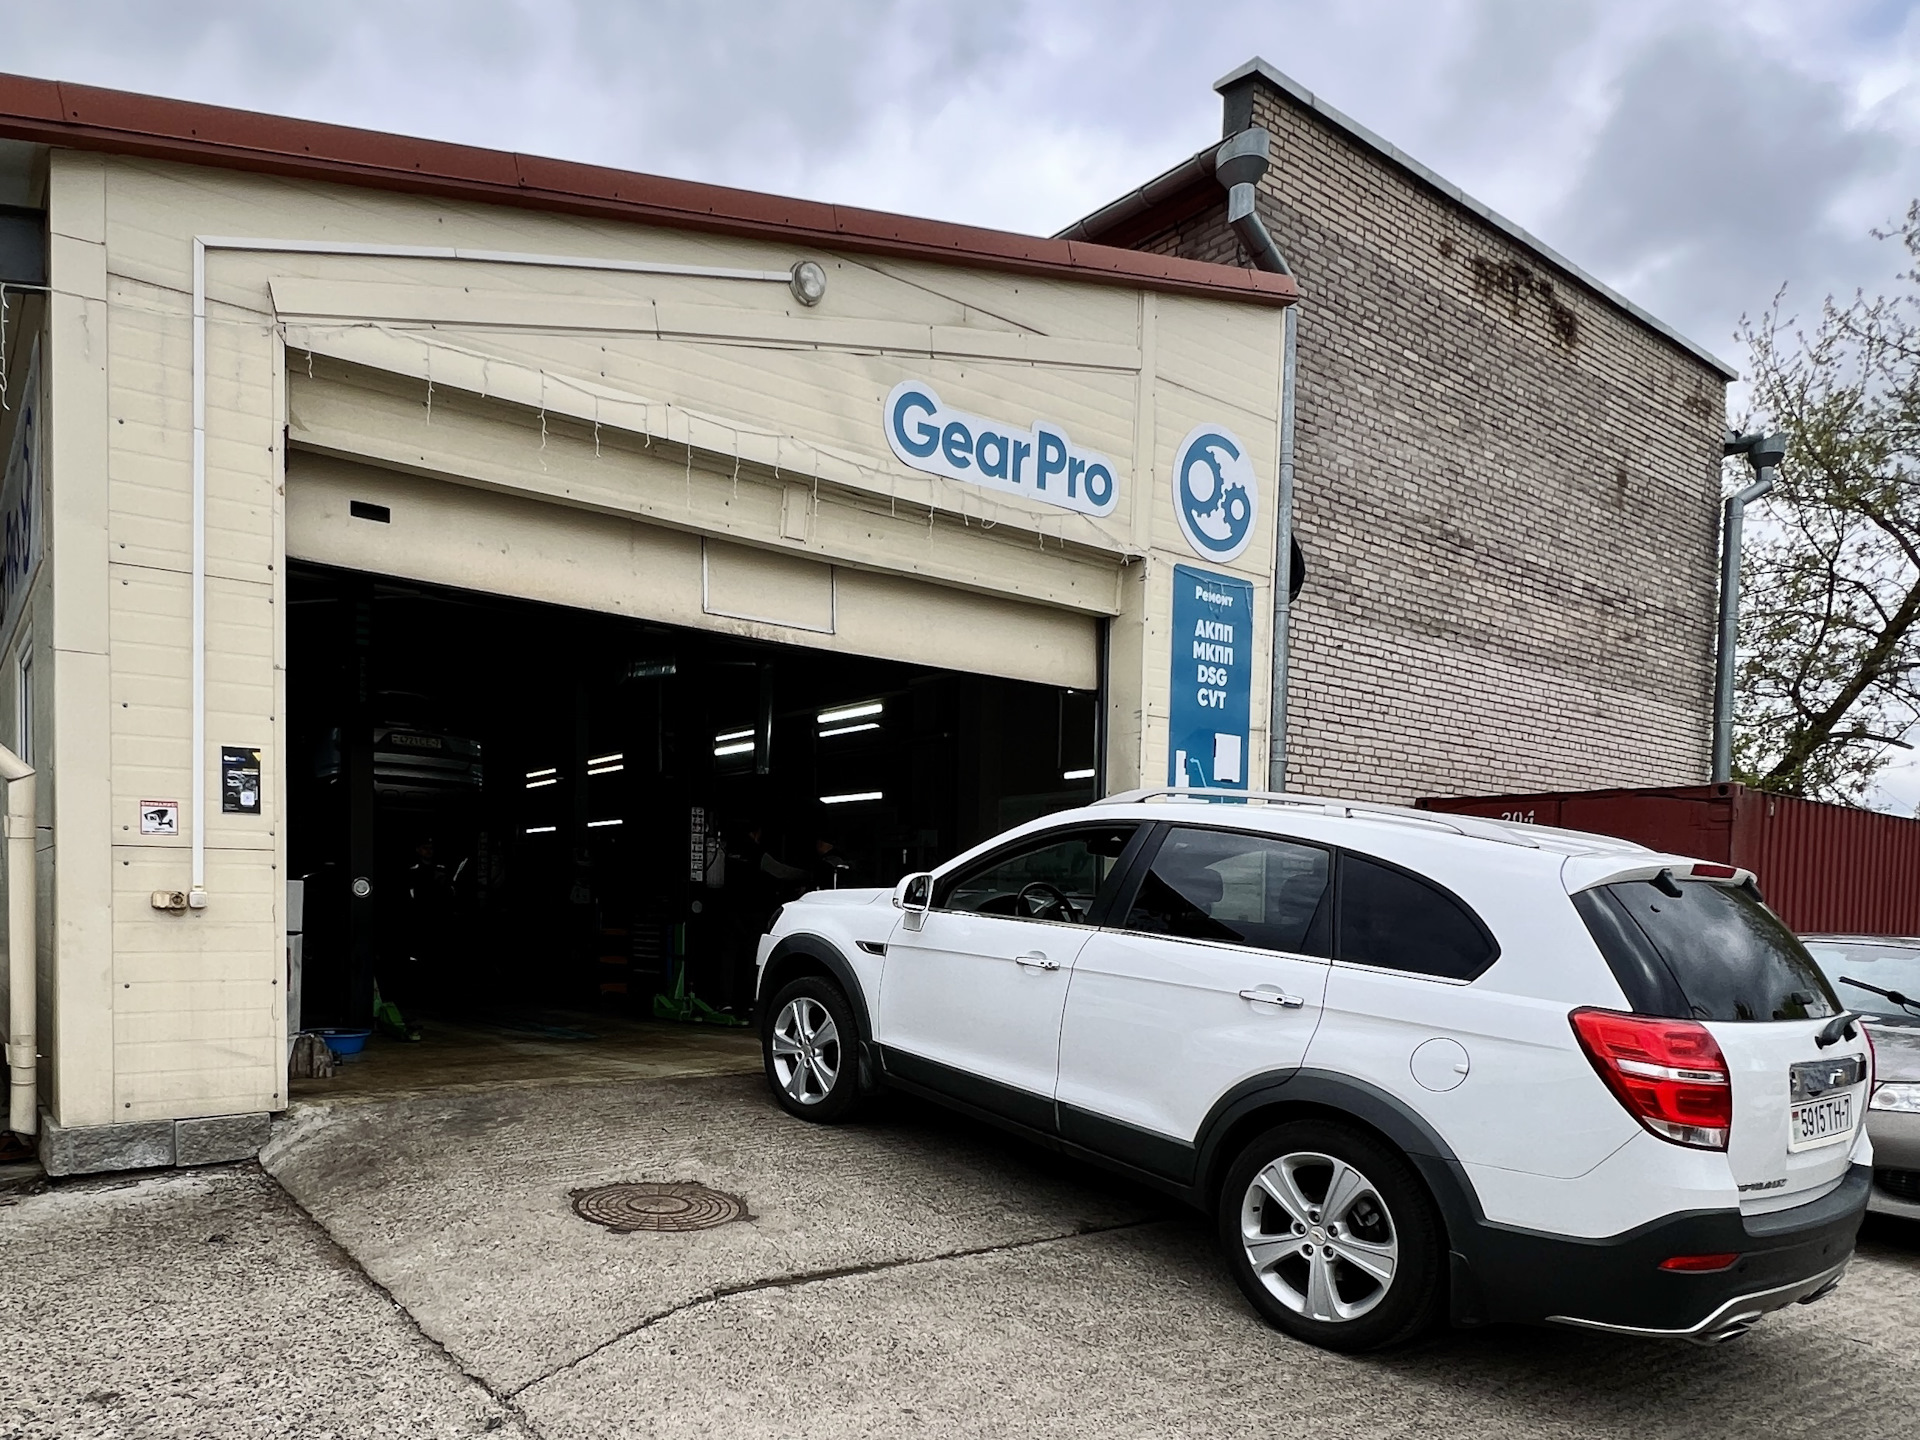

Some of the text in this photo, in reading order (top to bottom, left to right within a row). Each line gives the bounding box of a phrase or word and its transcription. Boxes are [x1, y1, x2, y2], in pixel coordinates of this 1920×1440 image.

[893, 391, 1113, 507] GearPro
[1195, 585, 1234, 607] Ремонт
[1194, 619, 1234, 643] АКПП
[1192, 641, 1234, 666] МКПП
[1197, 664, 1228, 687] DSG
[1197, 688, 1227, 709] CVT
